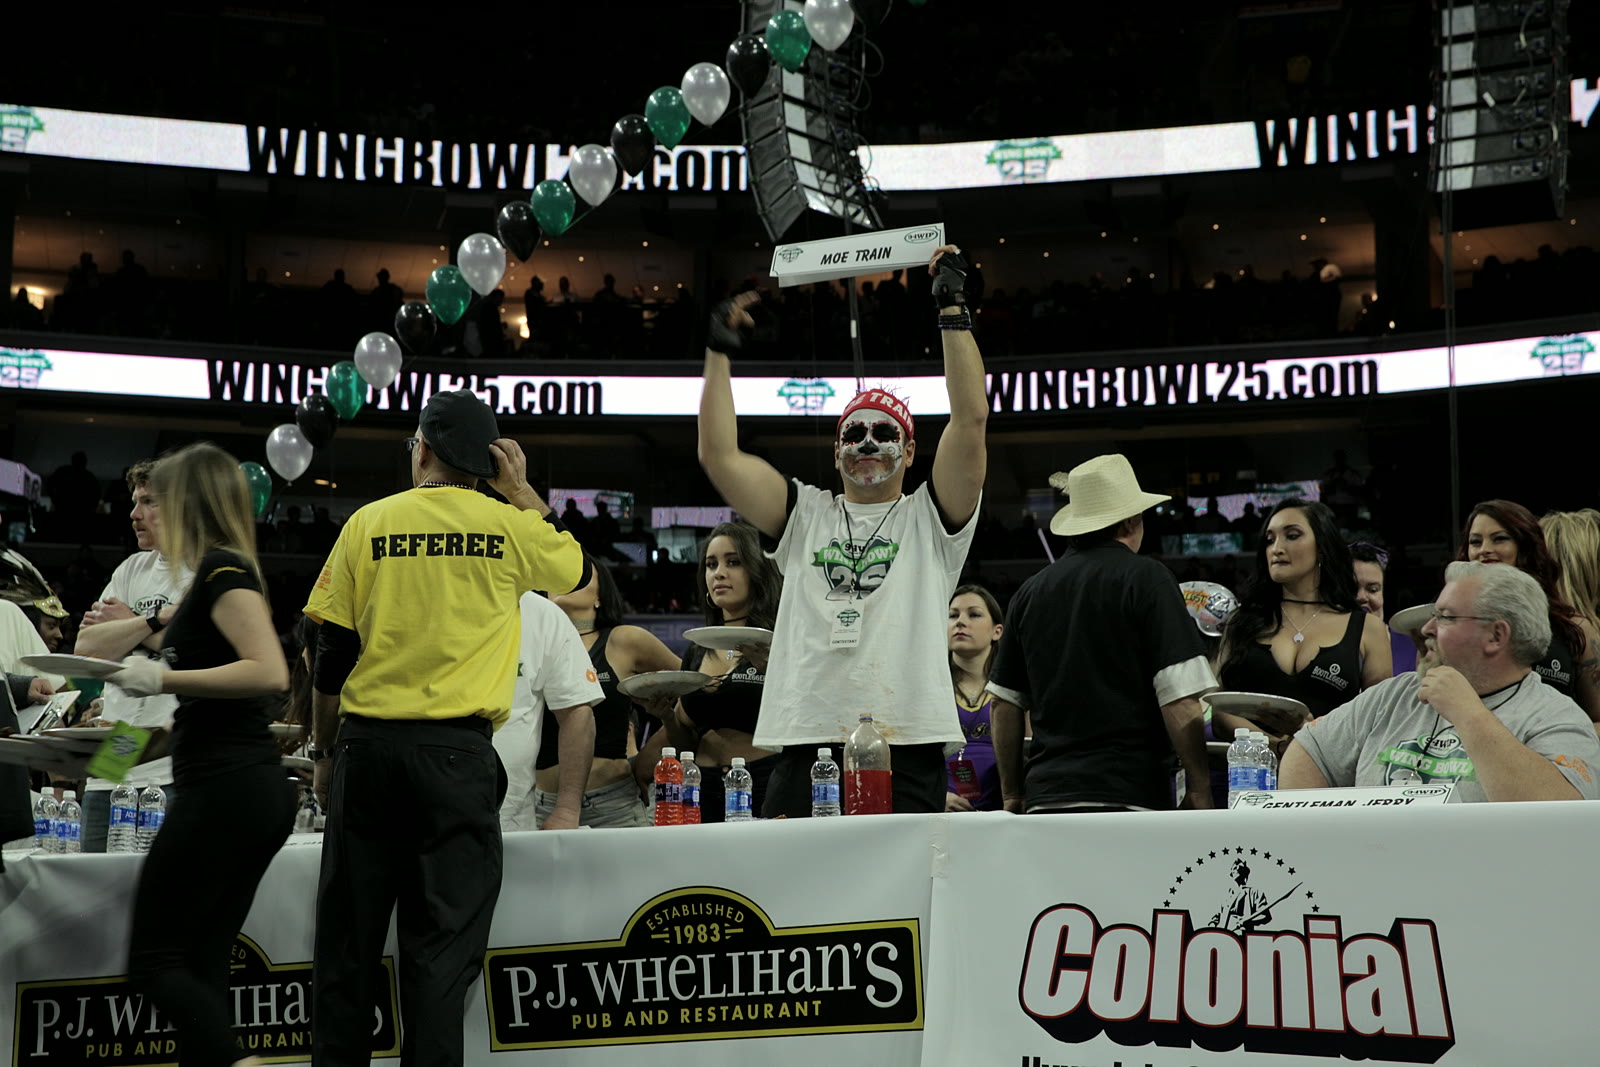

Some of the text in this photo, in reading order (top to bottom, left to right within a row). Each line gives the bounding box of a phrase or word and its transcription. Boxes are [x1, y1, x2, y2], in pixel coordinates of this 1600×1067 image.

[820, 251, 849, 265] MOE
[855, 246, 892, 262] TRAIN
[371, 532, 505, 561] REFEREE
[646, 903, 744, 931] ESTABLISHED
[674, 923, 720, 944] 1983
[503, 962, 578, 1028] P.J.
[1019, 903, 1454, 1058] Colonial
[30, 997, 94, 1057] P.J.
[572, 1000, 822, 1030] PUB AND RESTAURANT
[86, 1043, 124, 1058] PUB
[134, 1040, 177, 1056] AND
